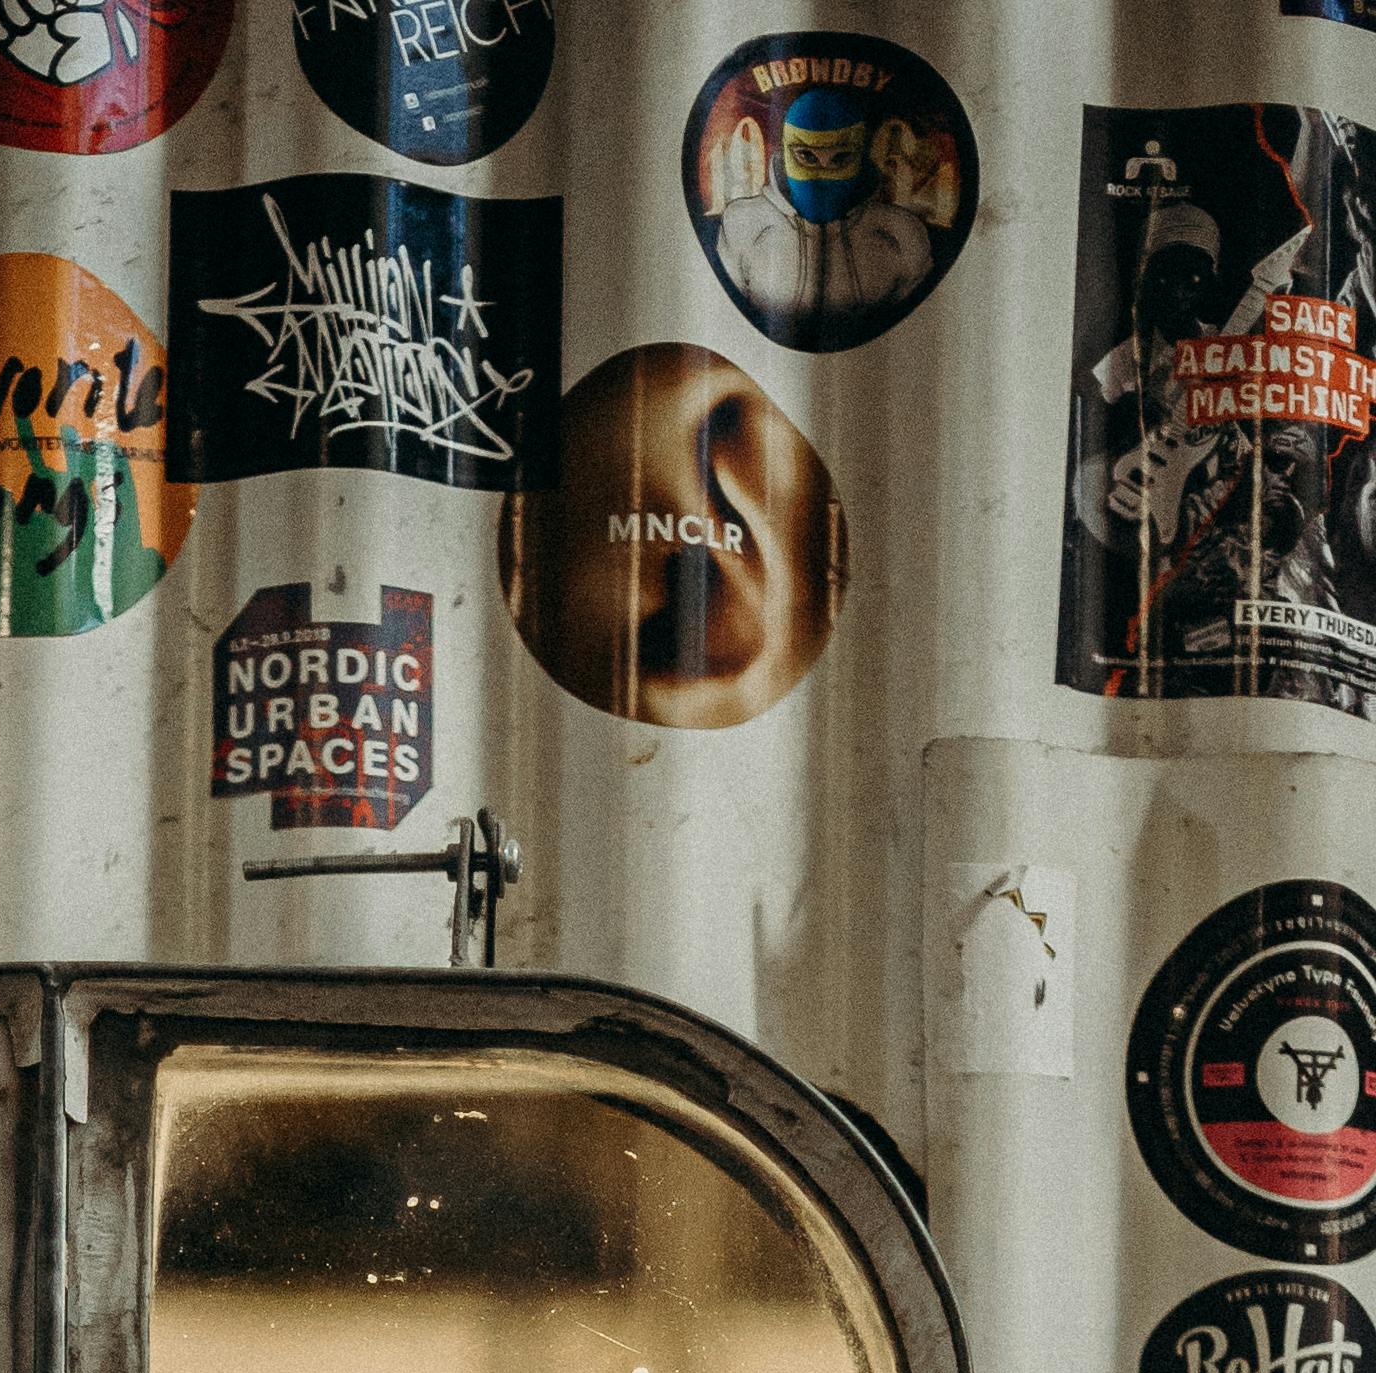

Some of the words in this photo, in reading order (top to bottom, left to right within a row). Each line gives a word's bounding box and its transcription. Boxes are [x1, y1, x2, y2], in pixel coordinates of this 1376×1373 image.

[1272, 300, 1354, 343] SAGE
[1177, 339, 1335, 382] AGAINST
[1191, 382, 1364, 429] MASCHINE
[608, 512, 744, 557] MNCLR
[1241, 603, 1311, 627] EVERY
[228, 648, 422, 694] NORDIC
[227, 694, 420, 739] URBAN
[226, 738, 421, 785] SPACES
[1301, 964, 1343, 988] Type
